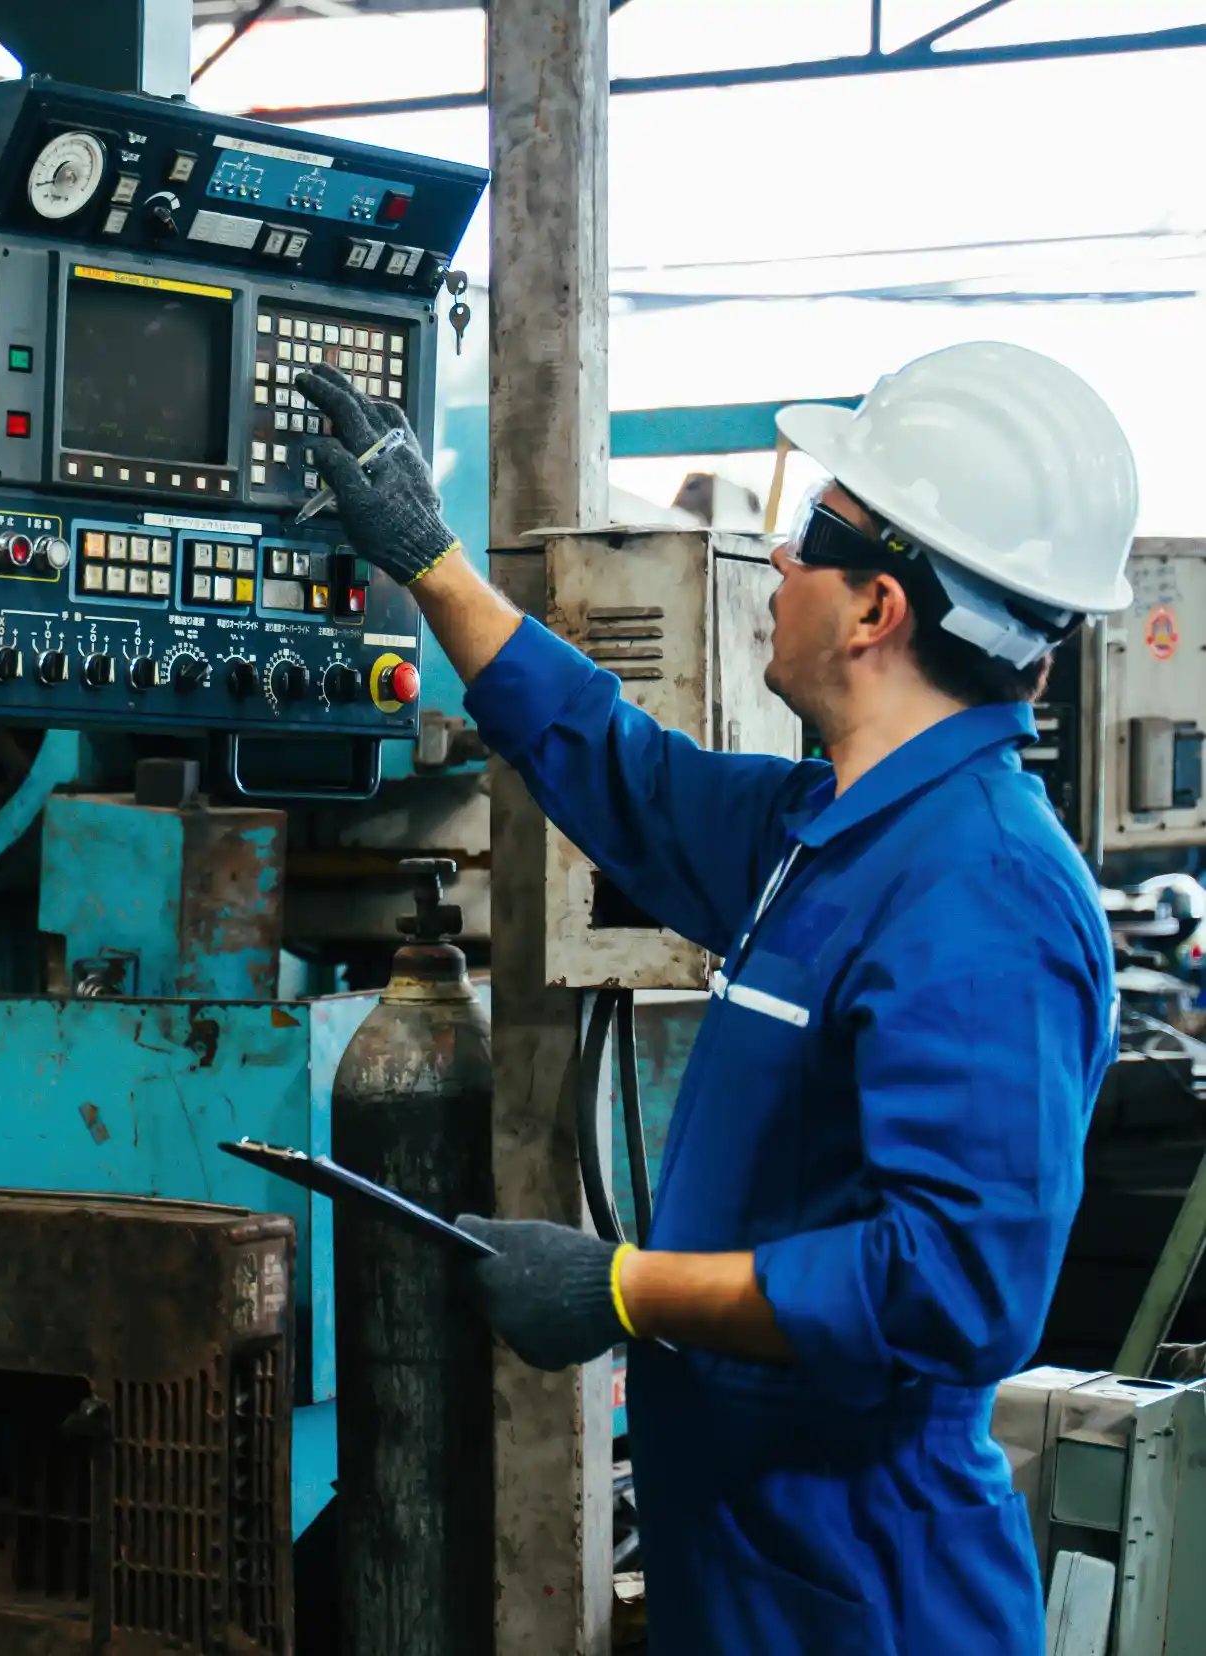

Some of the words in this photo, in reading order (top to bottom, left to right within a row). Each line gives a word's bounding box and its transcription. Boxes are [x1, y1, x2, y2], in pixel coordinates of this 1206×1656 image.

[44, 620, 52, 630] Y
[90, 623, 97, 633] Z
[134, 627, 142, 637] 4
